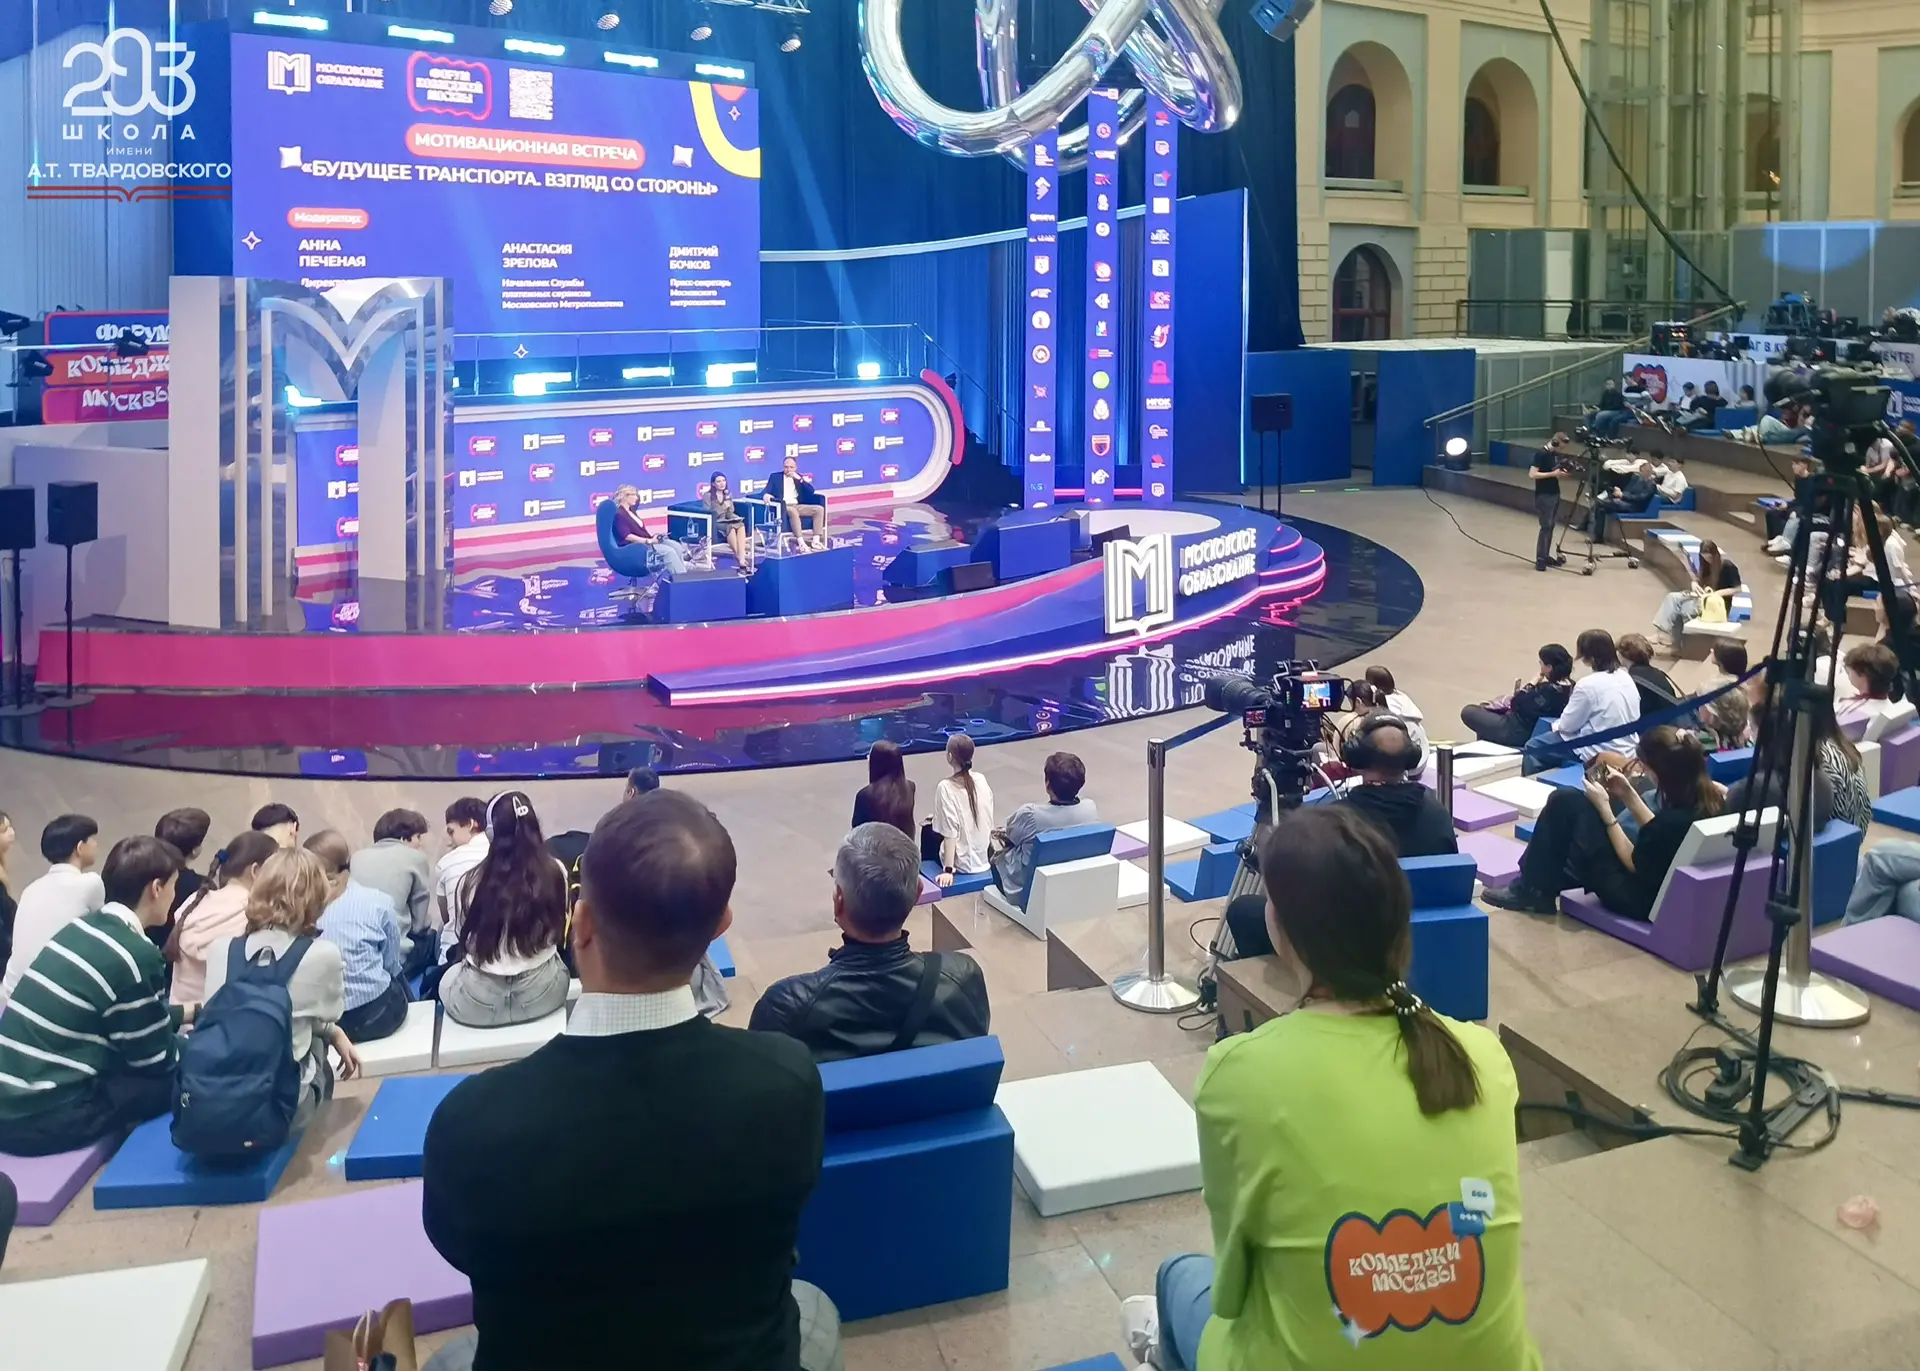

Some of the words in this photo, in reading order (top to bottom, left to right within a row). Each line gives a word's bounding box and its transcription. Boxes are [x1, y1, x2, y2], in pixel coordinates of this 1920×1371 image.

[415, 131, 568, 156] МОТИВАЦИОННАЯ
[572, 143, 638, 161] ВСТРЕЧА
[301, 160, 412, 181] «БУДУЩЕЕ
[415, 165, 542, 186] ТРАНСПОРТА.
[545, 172, 609, 192] ВЗГЛЯД
[611, 177, 635, 191] СО
[637, 178, 719, 195] СТОРОНЫ»
[298, 239, 342, 251] АННА
[502, 243, 572, 255] АНАСТАСИЯ
[669, 245, 719, 258] ДМИТРИЙ
[299, 255, 366, 267] ПЕЧЕНАЯ
[502, 257, 558, 269] ЗРЕЛОВА
[670, 260, 711, 270] БОЧКОВ
[1180, 528, 1257, 568] МОСКОВСКОЕ
[1179, 553, 1256, 596] ОБРАЗОВАНИЕ
[1349, 1242, 1461, 1276] КОЛЛЕДЖИ
[1372, 1264, 1457, 1293] МОСКВЫ
